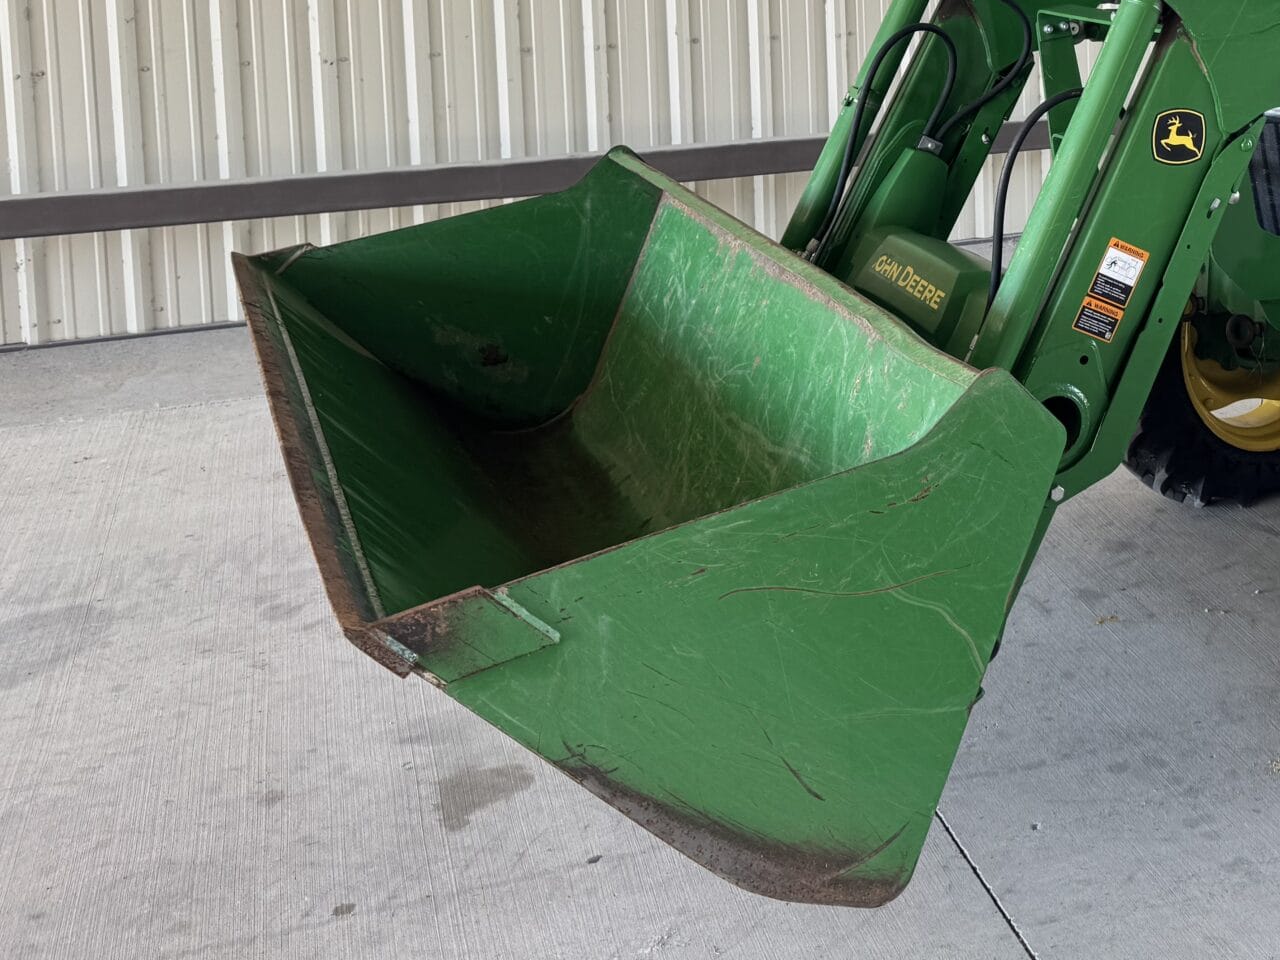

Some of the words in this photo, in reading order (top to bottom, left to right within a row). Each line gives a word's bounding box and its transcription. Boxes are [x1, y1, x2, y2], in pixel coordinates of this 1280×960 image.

[1120, 244, 1144, 258] WARNING
[872, 255, 902, 282] OHN
[898, 266, 946, 310] DEERE
[1094, 301, 1119, 316] WARNING
